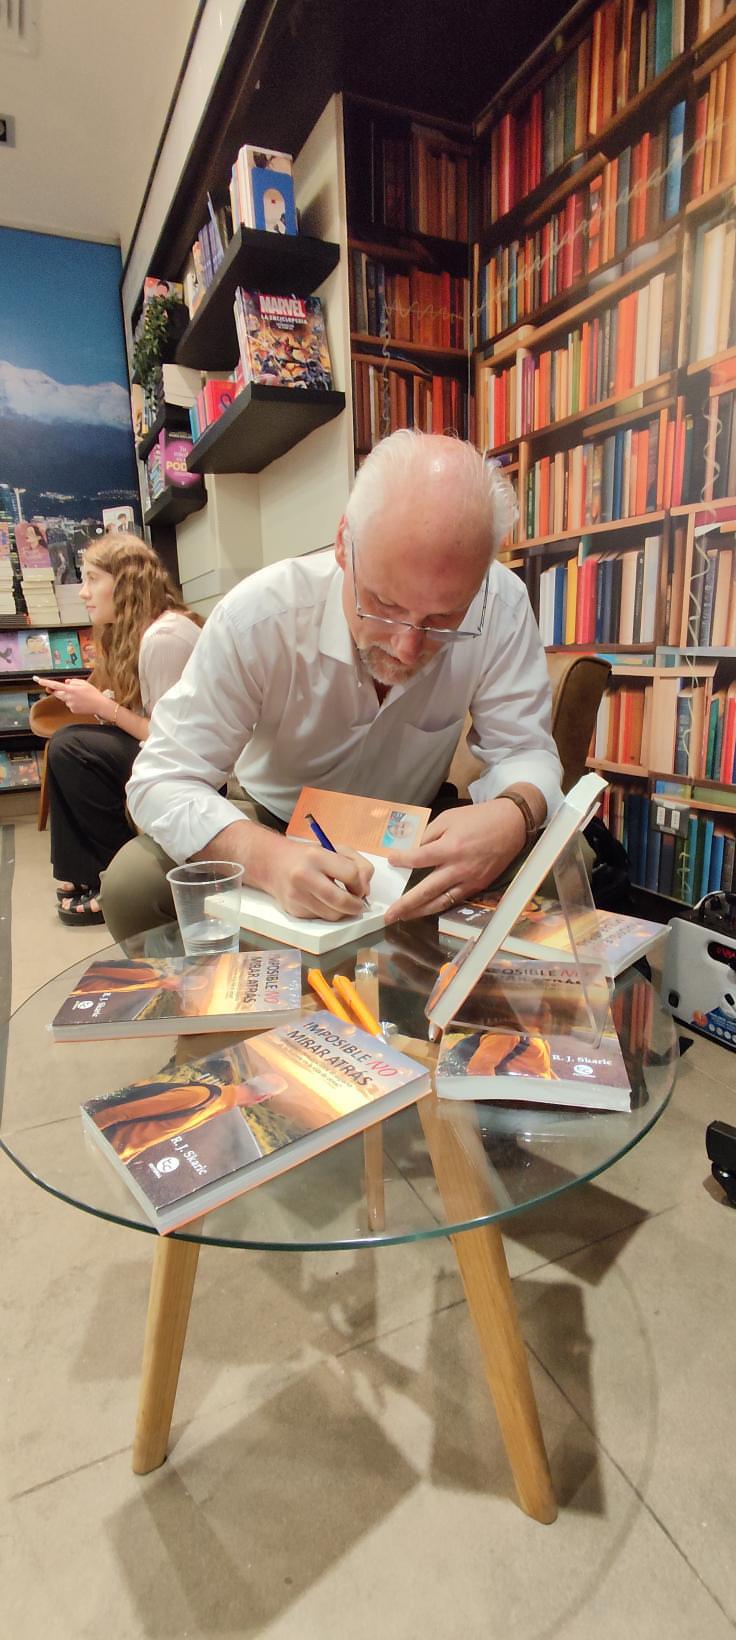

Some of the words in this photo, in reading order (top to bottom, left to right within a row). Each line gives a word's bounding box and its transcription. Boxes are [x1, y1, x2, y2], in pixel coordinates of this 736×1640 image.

[260, 295, 306, 317] MARVEL
[287, 1030, 330, 1058] MIRAR
[327, 1055, 373, 1086] ATRÁS
[303, 1021, 372, 1062] IMPOSIBLE
[366, 1059, 398, 1077] NO
[171, 1135, 182, 1147] R.
[174, 1144, 188, 1153] J.
